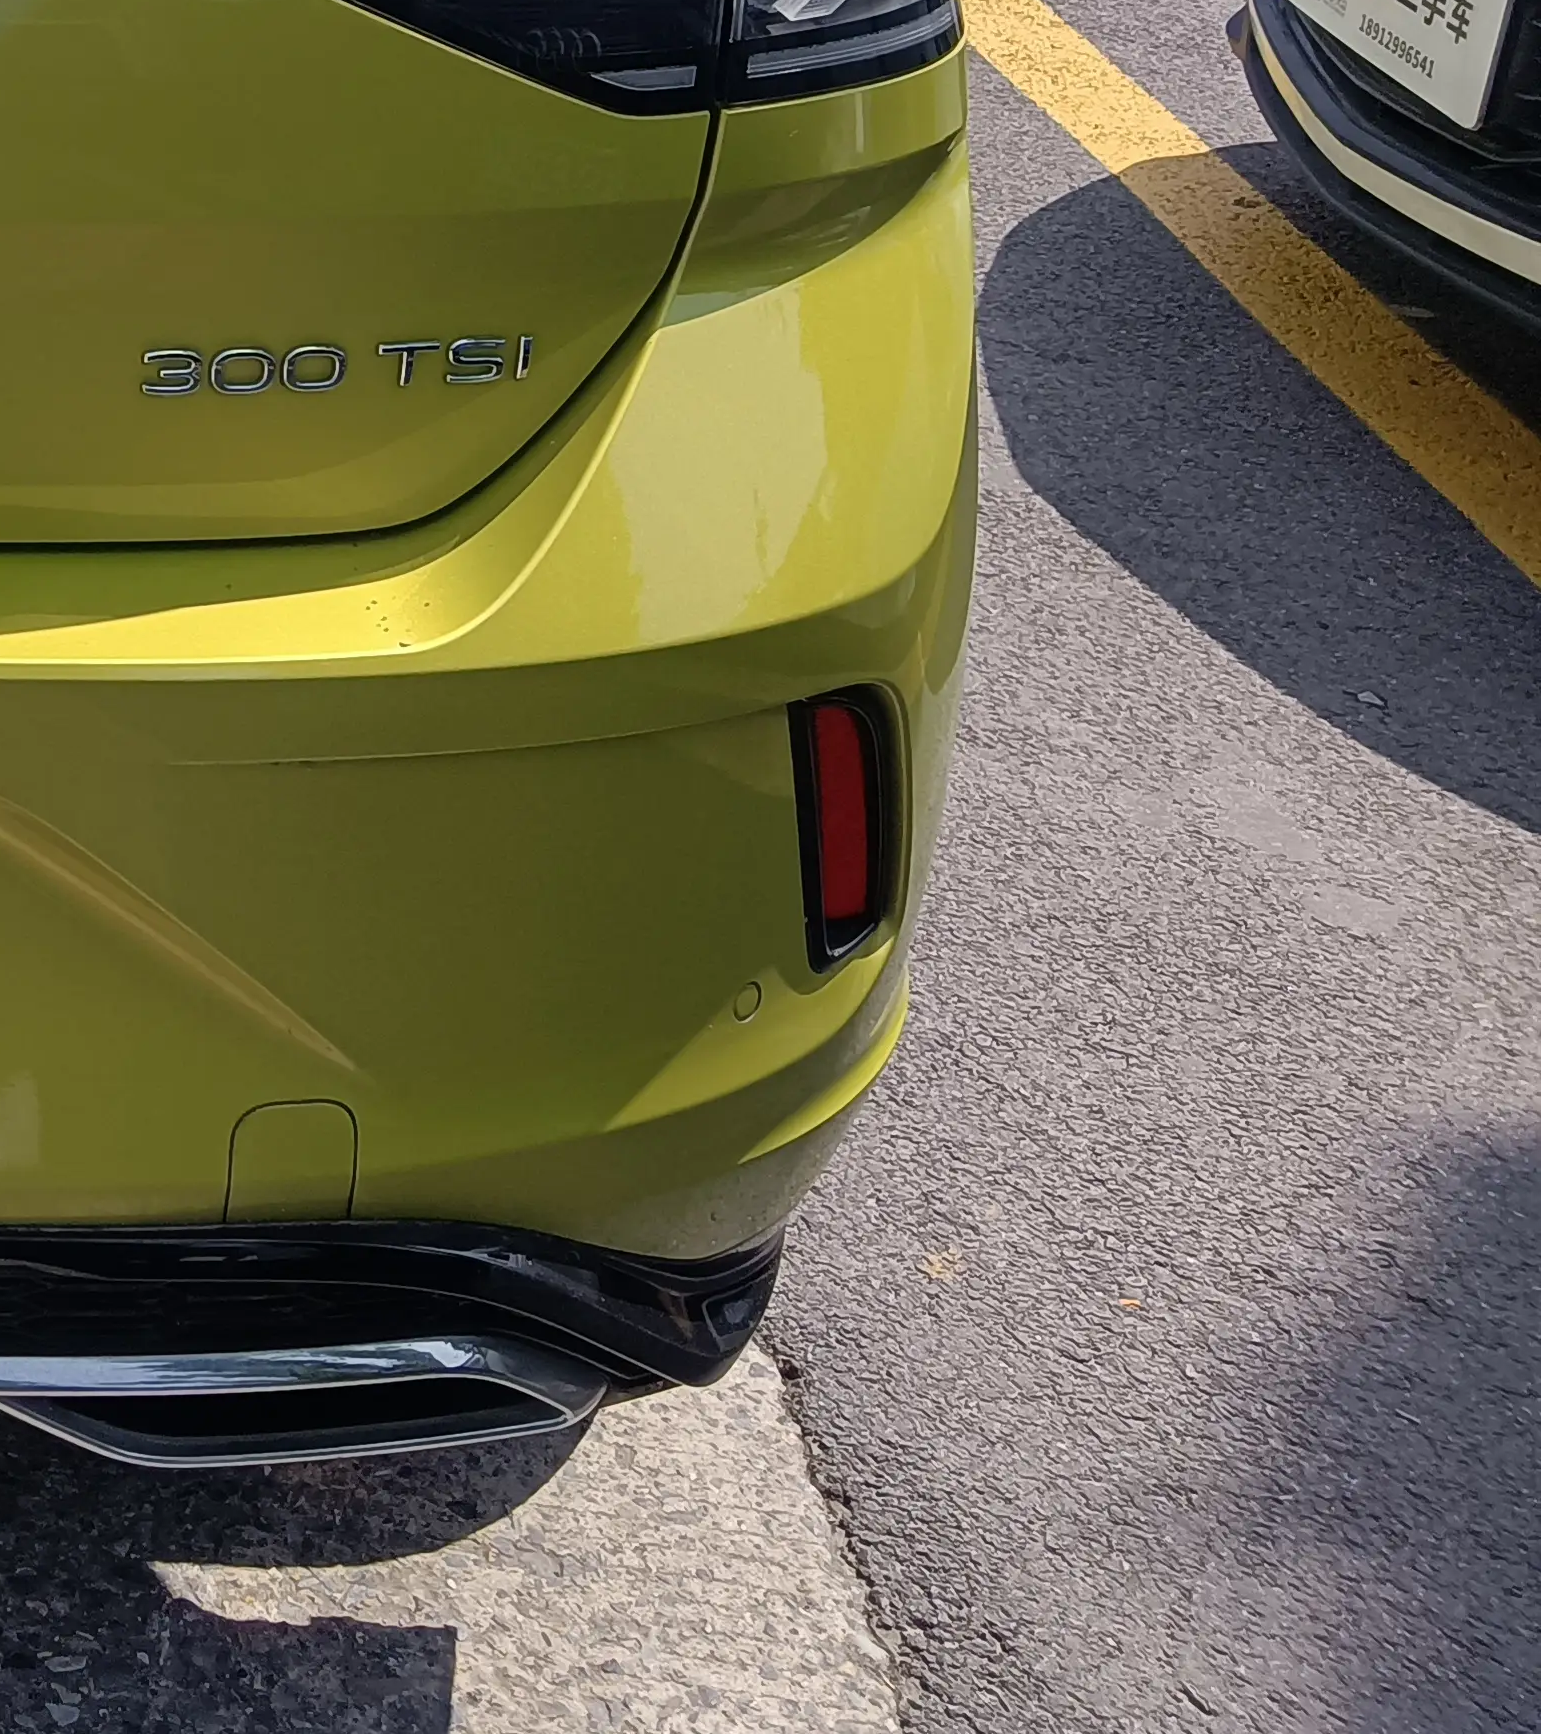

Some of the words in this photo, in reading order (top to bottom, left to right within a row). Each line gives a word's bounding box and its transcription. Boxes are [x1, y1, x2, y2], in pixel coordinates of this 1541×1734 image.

[1359, 14, 1435, 79] 18912996541
[141, 346, 348, 397] 300
[378, 334, 534, 387] TSI
